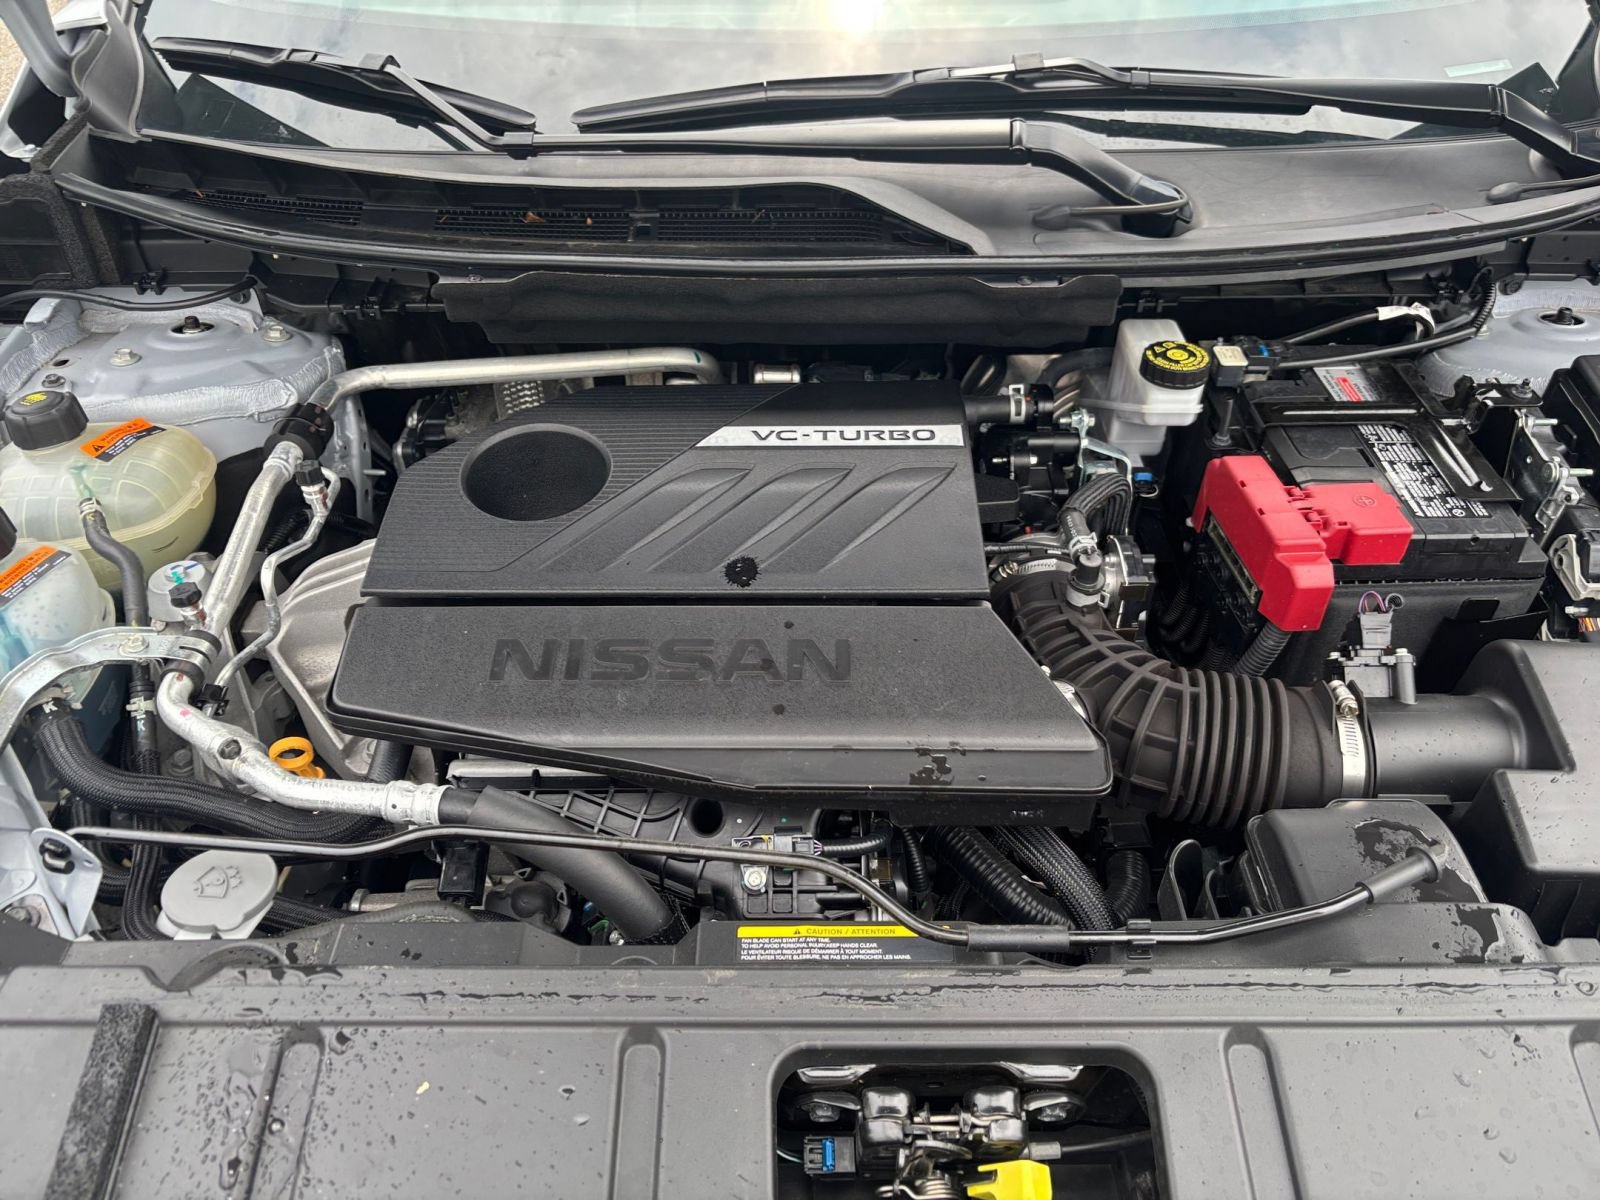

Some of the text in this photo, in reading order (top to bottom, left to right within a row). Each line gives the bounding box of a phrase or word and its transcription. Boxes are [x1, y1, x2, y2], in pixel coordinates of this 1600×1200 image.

[751, 429, 936, 441] VC-TURBO
[488, 637, 851, 683] NISSAN
[42, 701, 58, 713] K
[136, 720, 145, 731] K
